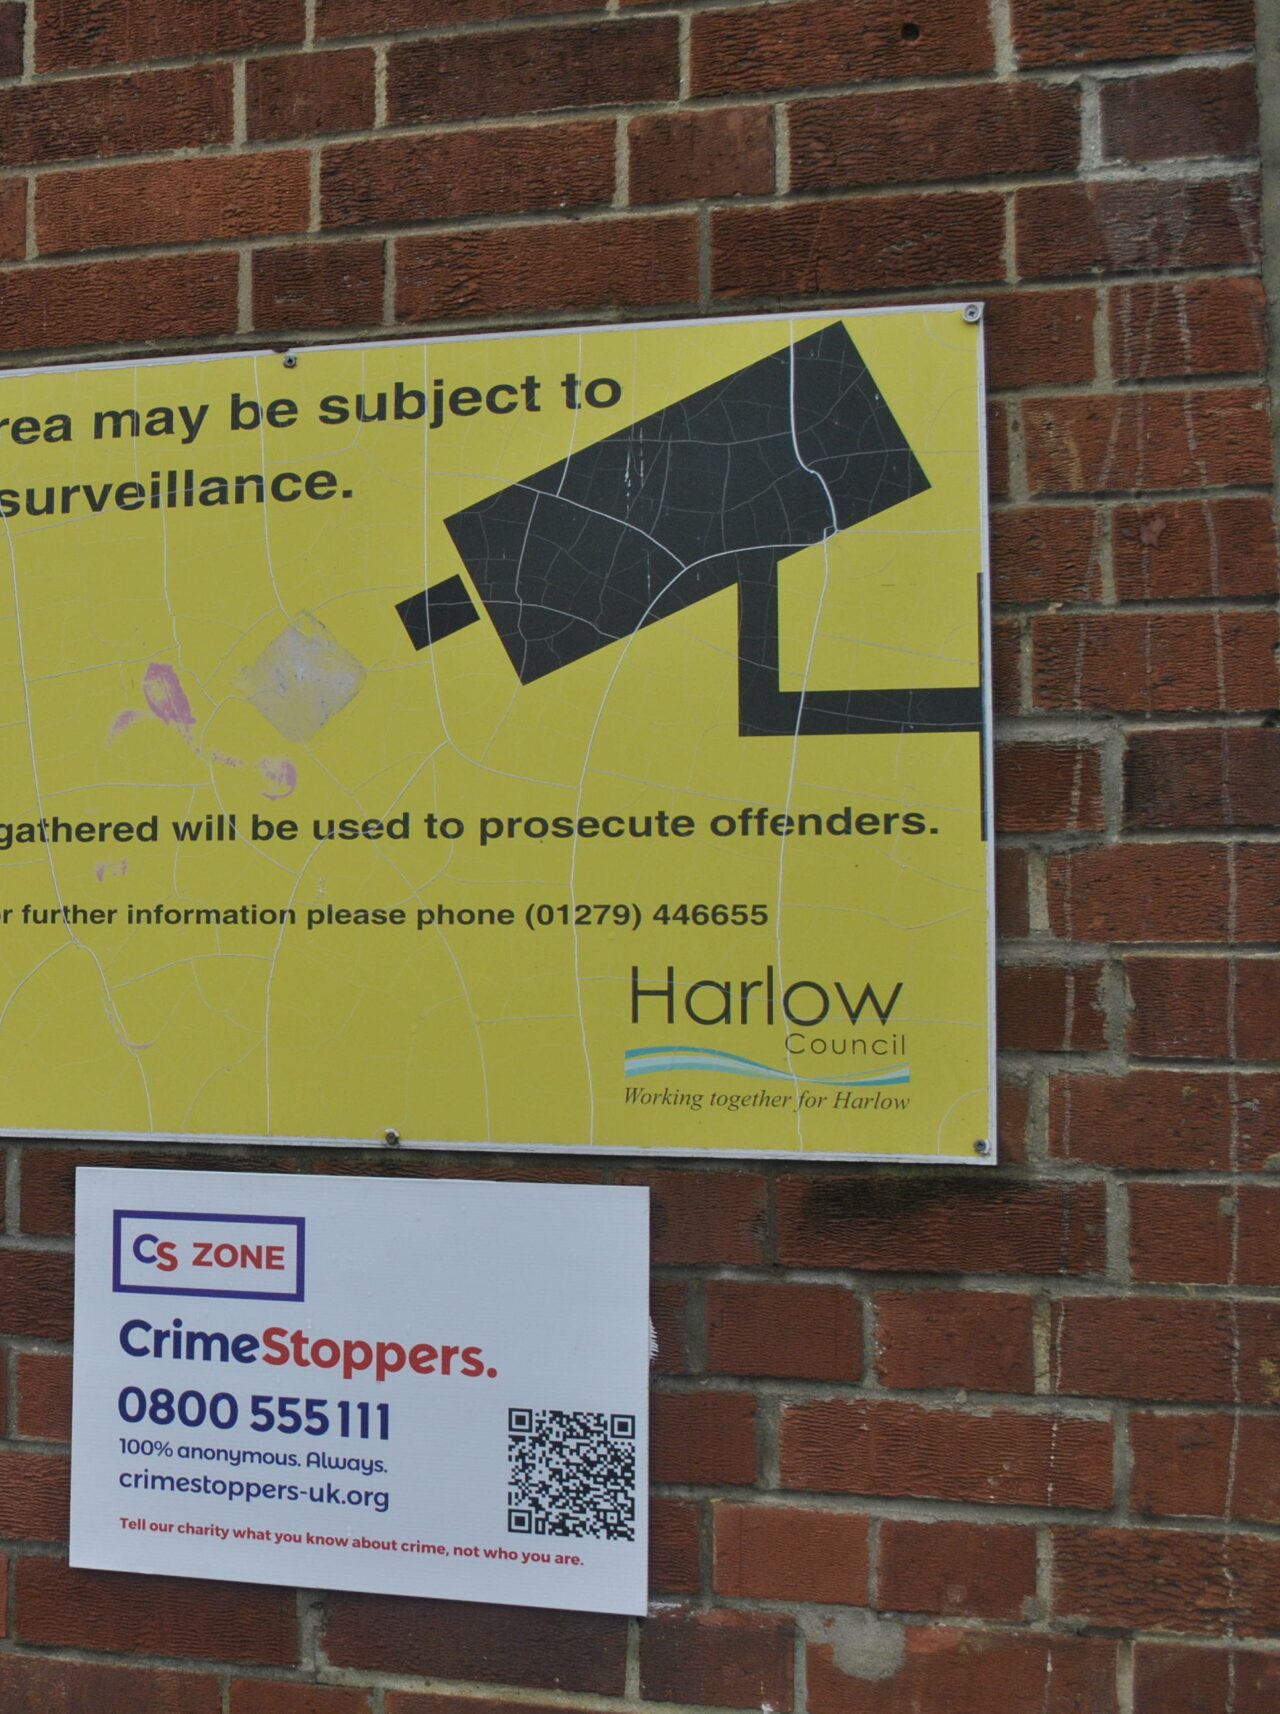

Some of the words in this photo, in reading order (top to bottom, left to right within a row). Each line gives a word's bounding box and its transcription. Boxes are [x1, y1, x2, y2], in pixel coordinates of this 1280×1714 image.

[93, 404, 210, 445] may
[230, 392, 299, 431] be
[318, 375, 541, 430] subject
[560, 372, 623, 410] to
[171, 814, 236, 842] will
[251, 813, 299, 842] be
[313, 811, 410, 841] used
[424, 813, 465, 840] to
[480, 810, 695, 847] prosecute
[710, 806, 939, 837] offenders.
[21, 903, 118, 925] further
[127, 903, 296, 926] information
[307, 903, 407, 931] please
[417, 903, 515, 931] phone
[525, 903, 642, 931] (01279)
[652, 903, 769, 926] 446655
[631, 965, 904, 1027] Harlow
[784, 1032, 906, 1056] Council
[624, 1086, 704, 1111] Working
[709, 1089, 792, 1112] together
[796, 1089, 827, 1113] for
[832, 1091, 911, 1110] Harlow
[133, 1233, 178, 1272] CS
[192, 1242, 285, 1270] ZONE
[119, 1318, 498, 1382] CrimeStoppers.
[118, 1386, 238, 1430] 0800
[250, 1395, 331, 1438] 555
[337, 1400, 391, 1442] 111
[120, 1438, 174, 1459] 100%
[177, 1446, 302, 1468] anonymous.
[306, 1452, 388, 1475] Always.
[119, 1468, 390, 1512] crimestoppers-uk.org
[120, 1517, 146, 1531] Tell
[149, 1521, 174, 1534] our
[177, 1521, 230, 1540] charity
[233, 1526, 272, 1541] what
[274, 1531, 303, 1546] you
[305, 1531, 349, 1547] know
[351, 1535, 398, 1551] about
[400, 1539, 450, 1557] crime,
[453, 1544, 480, 1558] not
[482, 1545, 519, 1561] who
[521, 1550, 551, 1566] you
[553, 1553, 585, 1566] are.
